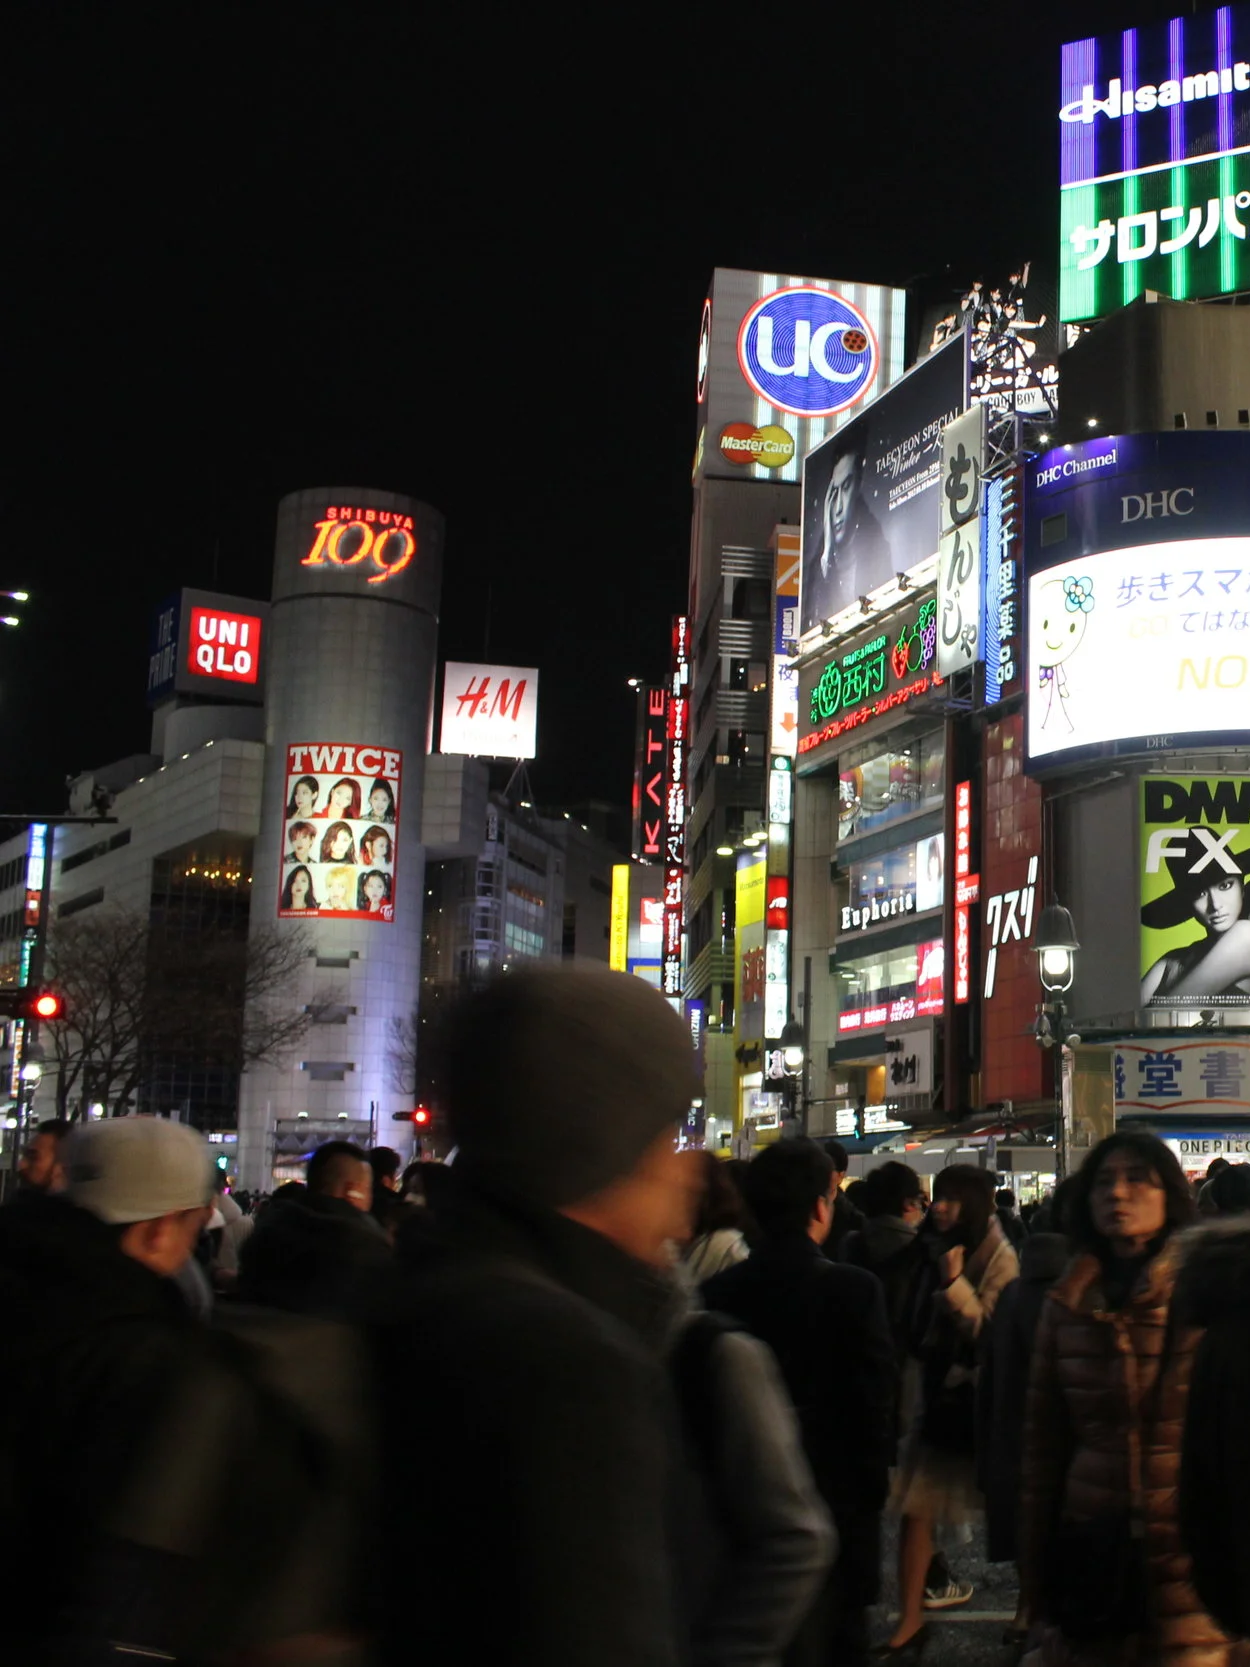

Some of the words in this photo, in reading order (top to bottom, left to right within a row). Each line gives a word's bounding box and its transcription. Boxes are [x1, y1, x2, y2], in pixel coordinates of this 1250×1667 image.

[757, 315, 864, 383] UC
[1016, 391, 1037, 406] BOY
[720, 435, 794, 454] MasterCard
[1036, 466, 1062, 489] DHC
[1062, 449, 1117, 476] Channel
[327, 506, 414, 530] SHIBUYA
[1120, 488, 1195, 524] DHC
[301, 519, 416, 583] 109
[943, 444, 979, 658] もんじゃ
[996, 474, 1017, 685] 三千里薬品
[199, 615, 248, 647] UNI
[196, 644, 251, 674] QLO
[456, 675, 527, 722] H&M
[842, 651, 886, 708] 西村
[290, 746, 400, 778] TWICE
[1146, 736, 1173, 748] DHC
[644, 688, 665, 854] KATE
[1145, 828, 1242, 874] FX
[841, 893, 913, 931] Euphoria
[986, 886, 1036, 946] クスリ
[691, 1008, 701, 1050] MIZUHO
[1180, 1140, 1210, 1153] ONE
